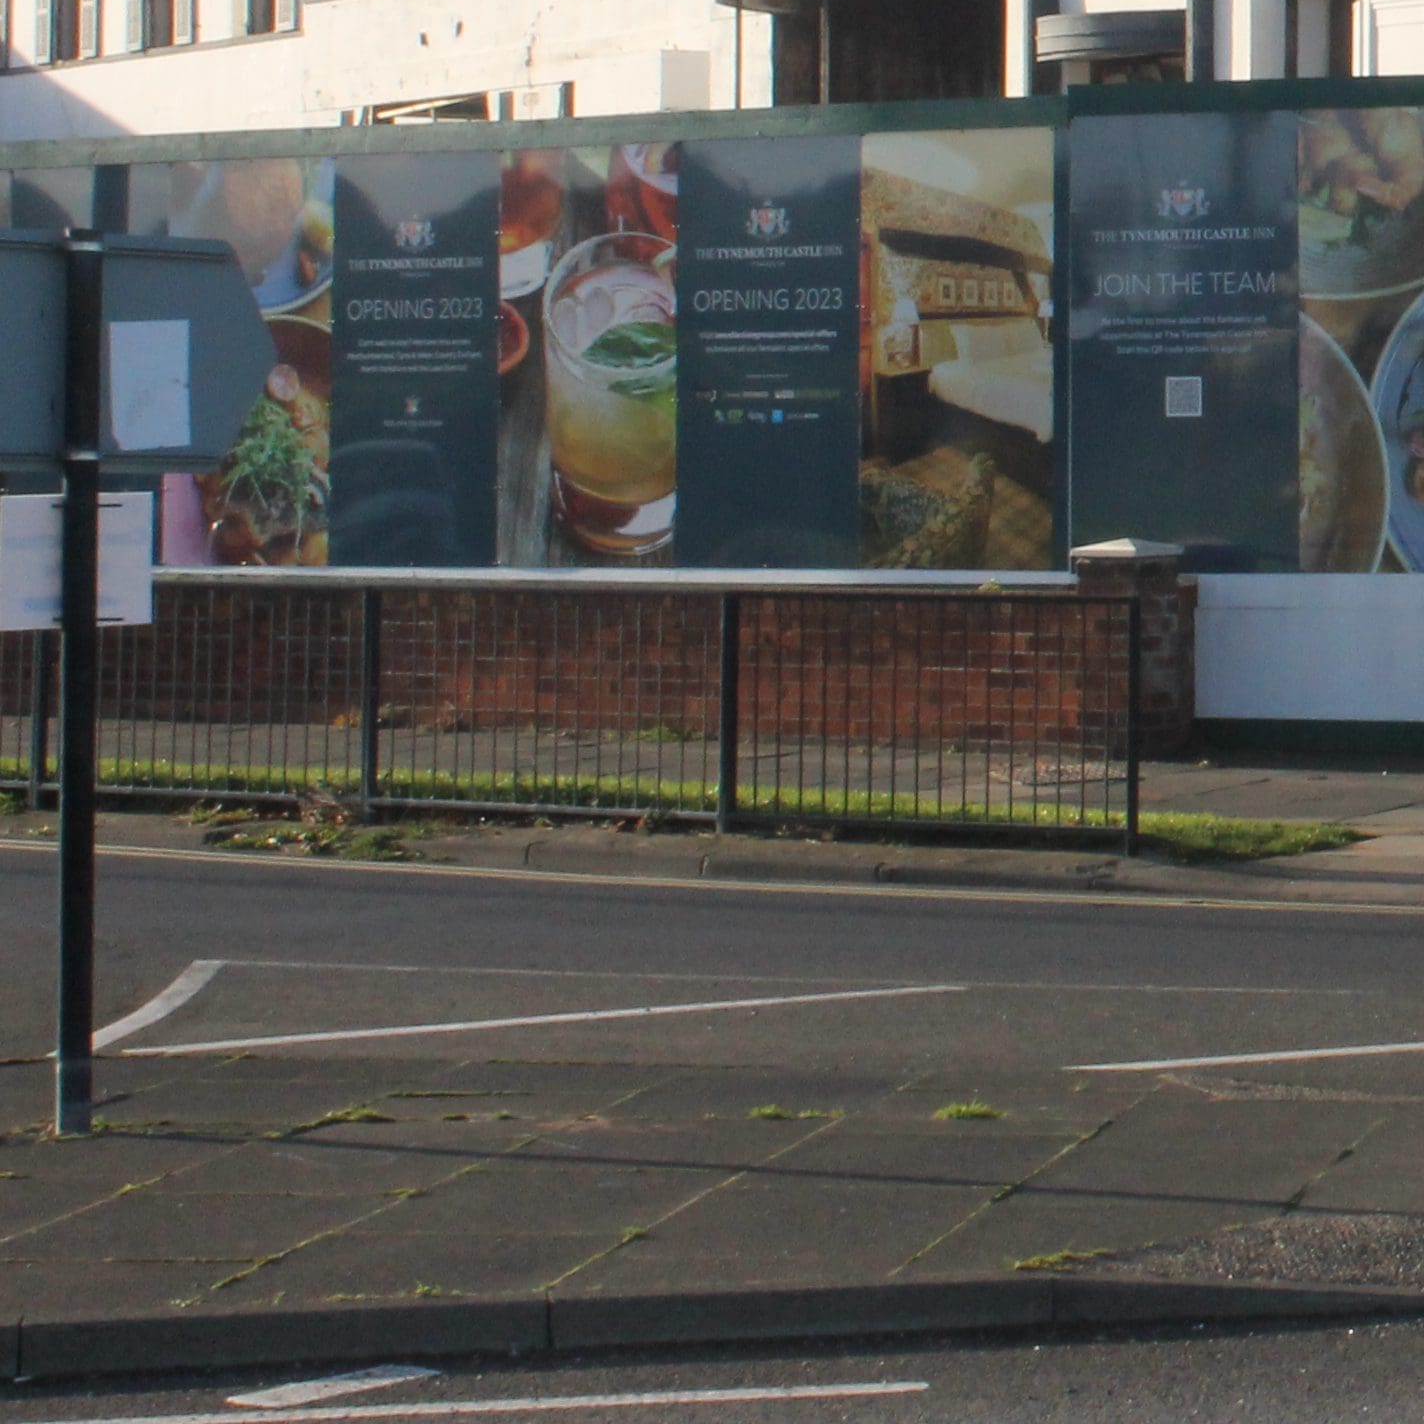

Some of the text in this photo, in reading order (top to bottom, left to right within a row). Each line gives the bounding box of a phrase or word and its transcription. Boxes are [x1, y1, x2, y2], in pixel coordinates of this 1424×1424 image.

[1094, 226, 1276, 242] THE TYNEMOUTH CASTLE INN
[716, 246, 783, 259] TYNEMOUTH
[784, 245, 821, 257] CASTLE
[368, 257, 429, 270] TYNEMOUTH
[430, 256, 463, 268] CASTLE
[1093, 271, 1277, 297] JOIN THE TEAM
[347, 297, 484, 321] OPENING 2023
[693, 287, 844, 313] OPENING 2023
